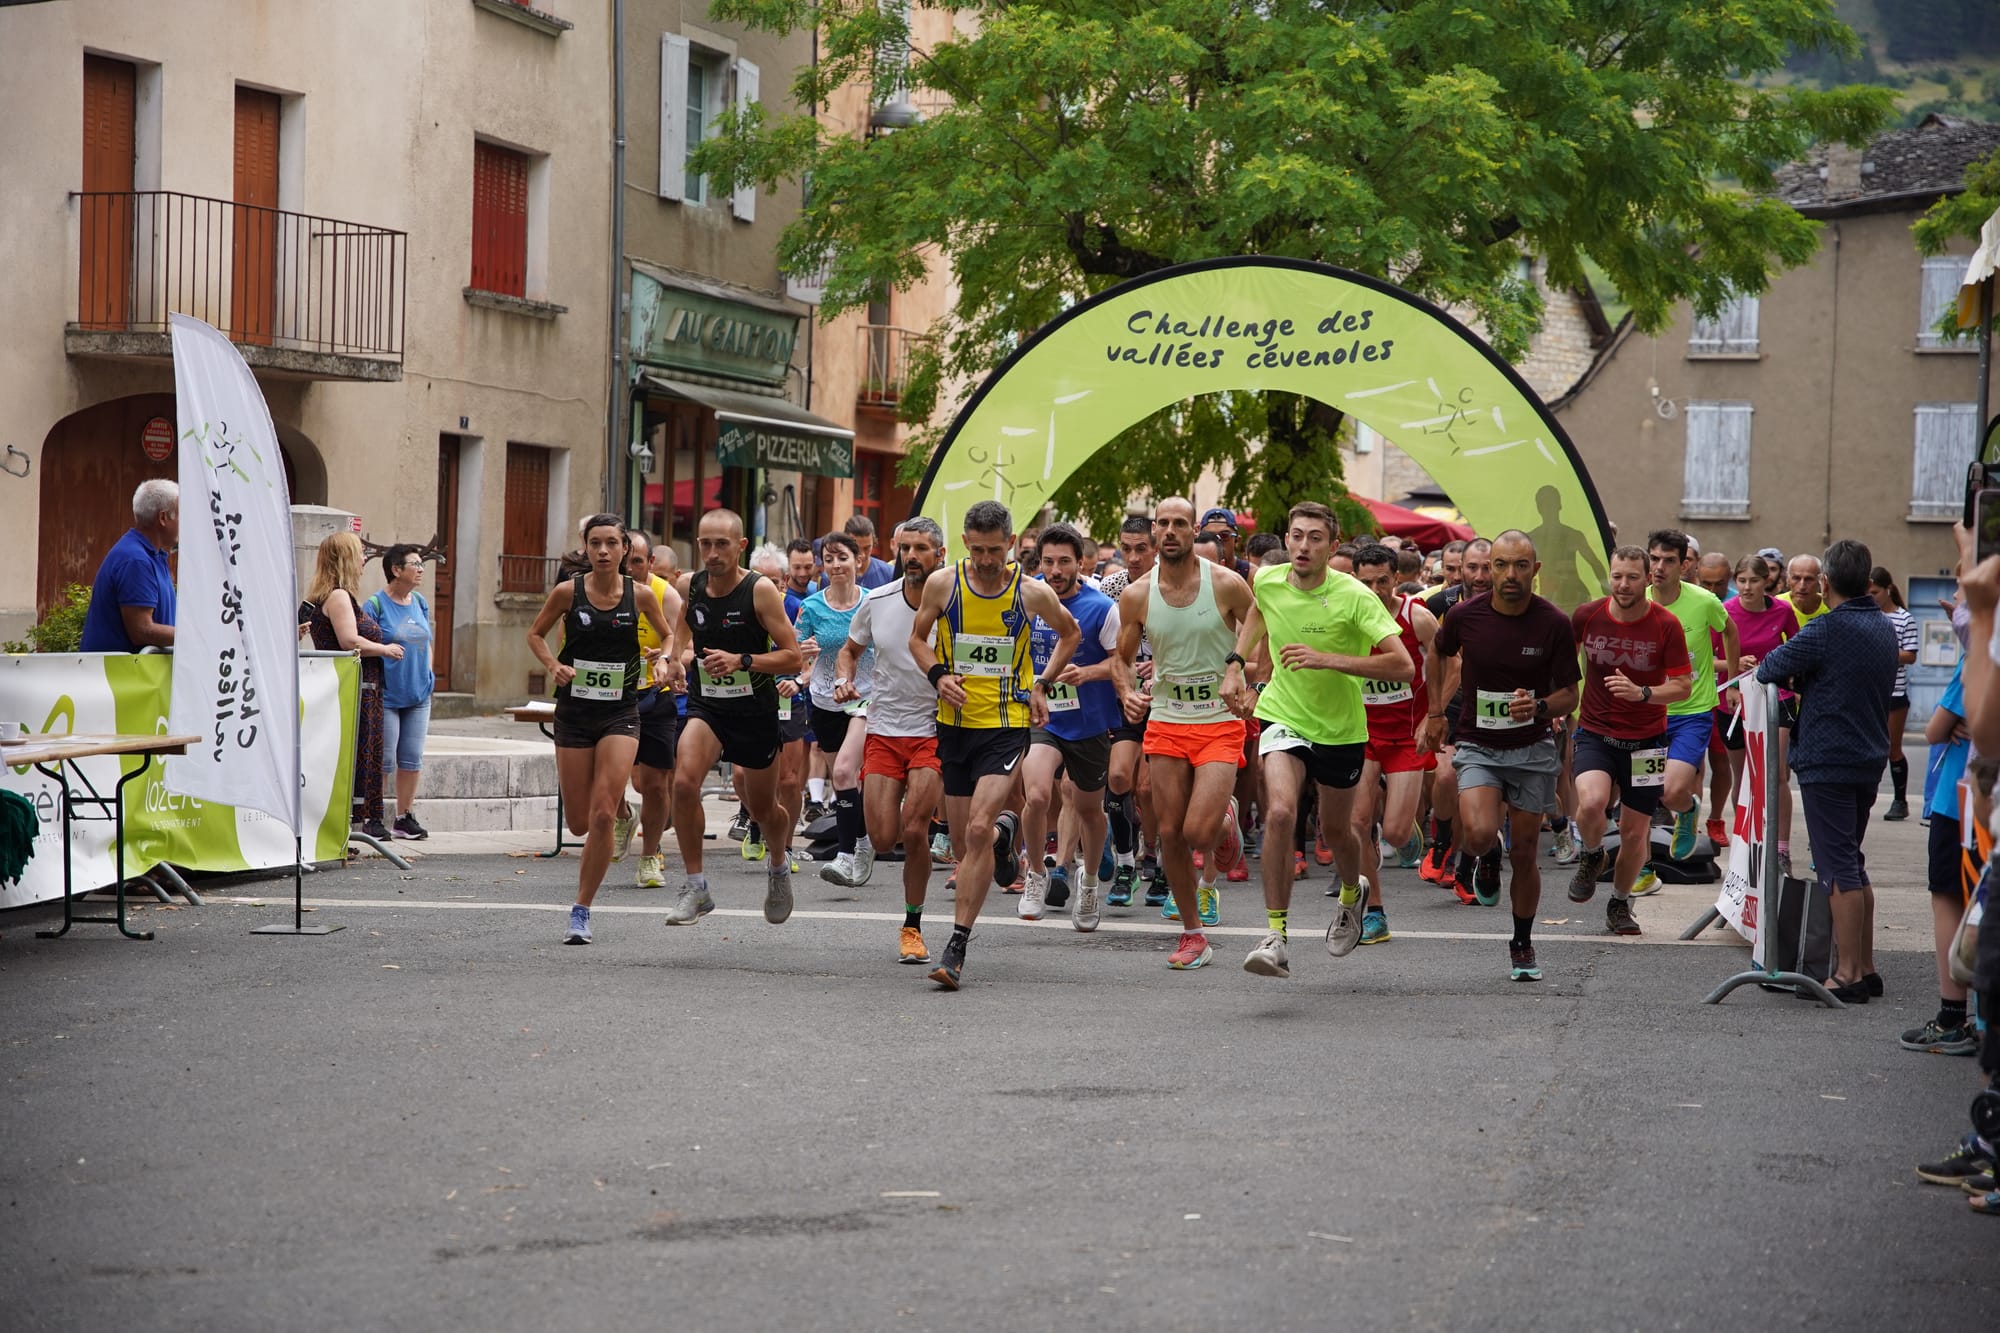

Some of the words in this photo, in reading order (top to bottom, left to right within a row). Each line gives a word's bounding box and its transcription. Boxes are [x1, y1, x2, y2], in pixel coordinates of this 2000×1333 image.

[665, 309, 704, 344] AU
[1127, 310, 1295, 347] Challenge
[1317, 310, 1374, 334] des
[1107, 342, 1225, 369] vallées
[1246, 340, 1394, 369] cévenoles
[757, 433, 821, 467] PIZZERIA
[969, 646, 998, 664] 48
[585, 672, 611, 688] 56
[1366, 680, 1402, 694] 100
[1047, 684, 1068, 699] 01
[1173, 685, 1211, 701] 115
[1485, 702, 1511, 717] 10
[1645, 758, 1666, 774] 35
